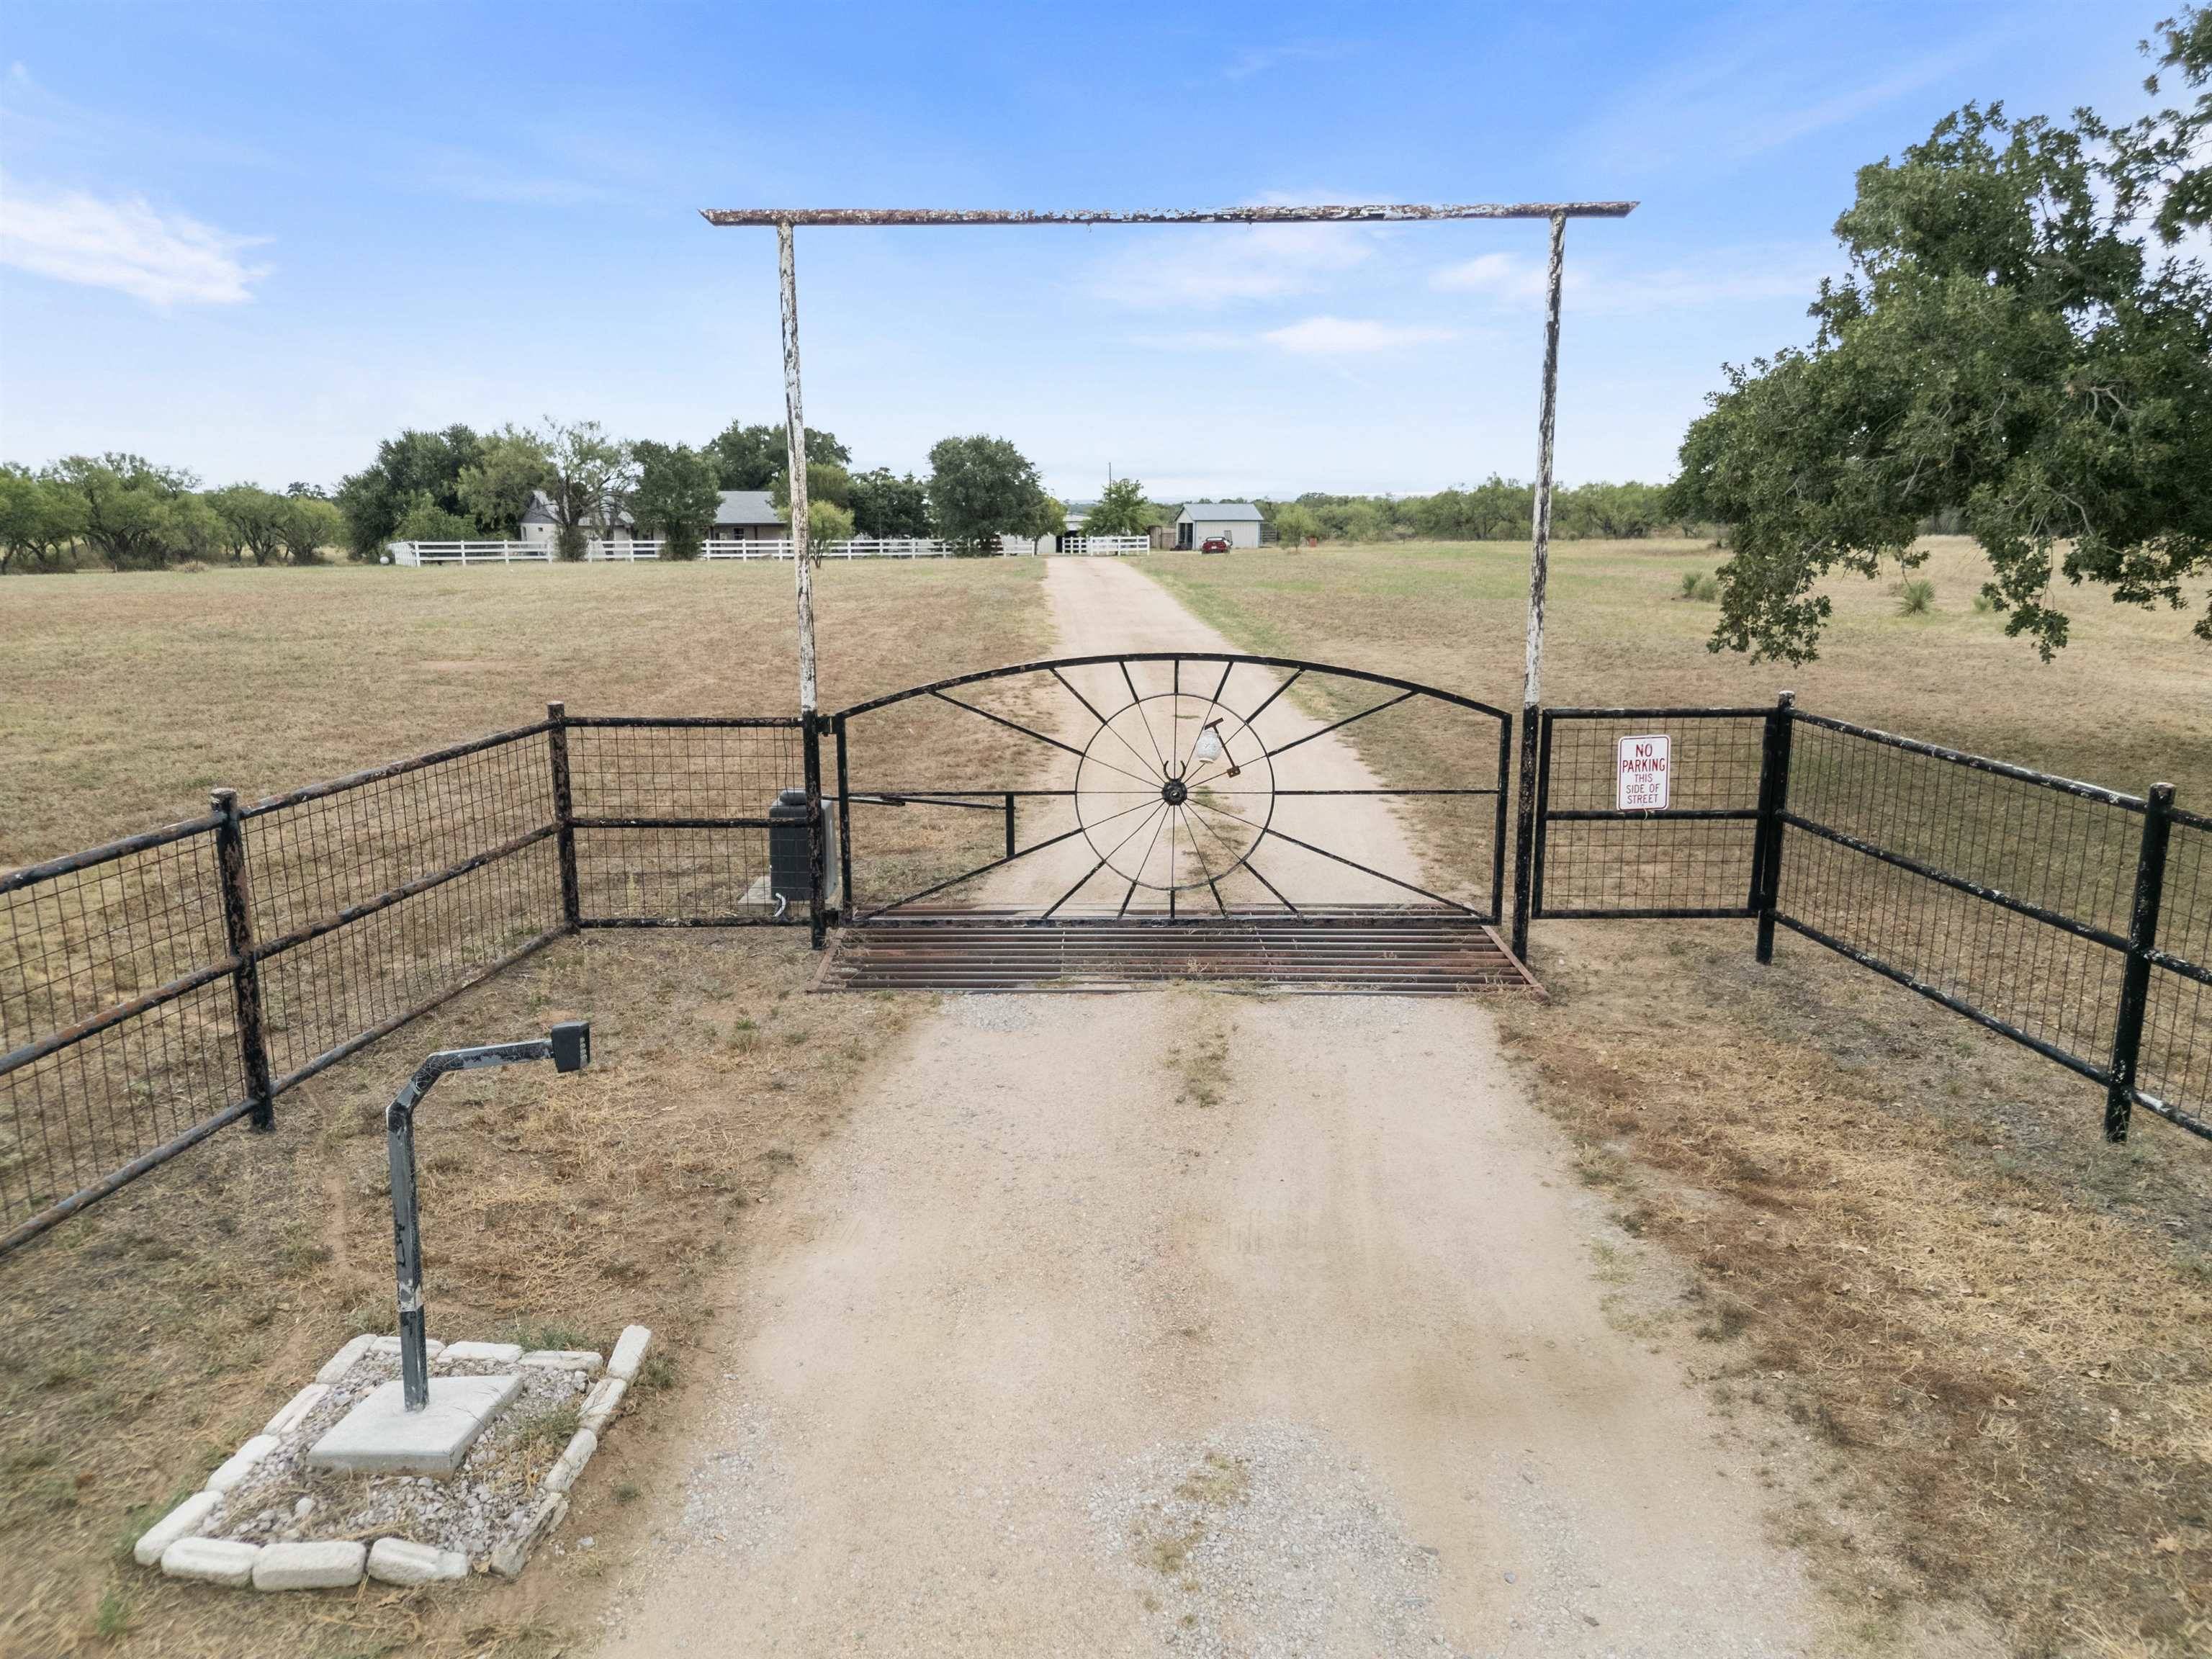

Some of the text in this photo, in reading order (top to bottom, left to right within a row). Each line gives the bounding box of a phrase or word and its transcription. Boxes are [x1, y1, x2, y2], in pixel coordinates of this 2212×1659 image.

[1635, 744, 1653, 757] NO
[1622, 758, 1665, 773] PARKING
[1635, 773, 1653, 783] THIS
[1626, 783, 1660, 793] SIDE OF
[1627, 794, 1659, 804] STREET
